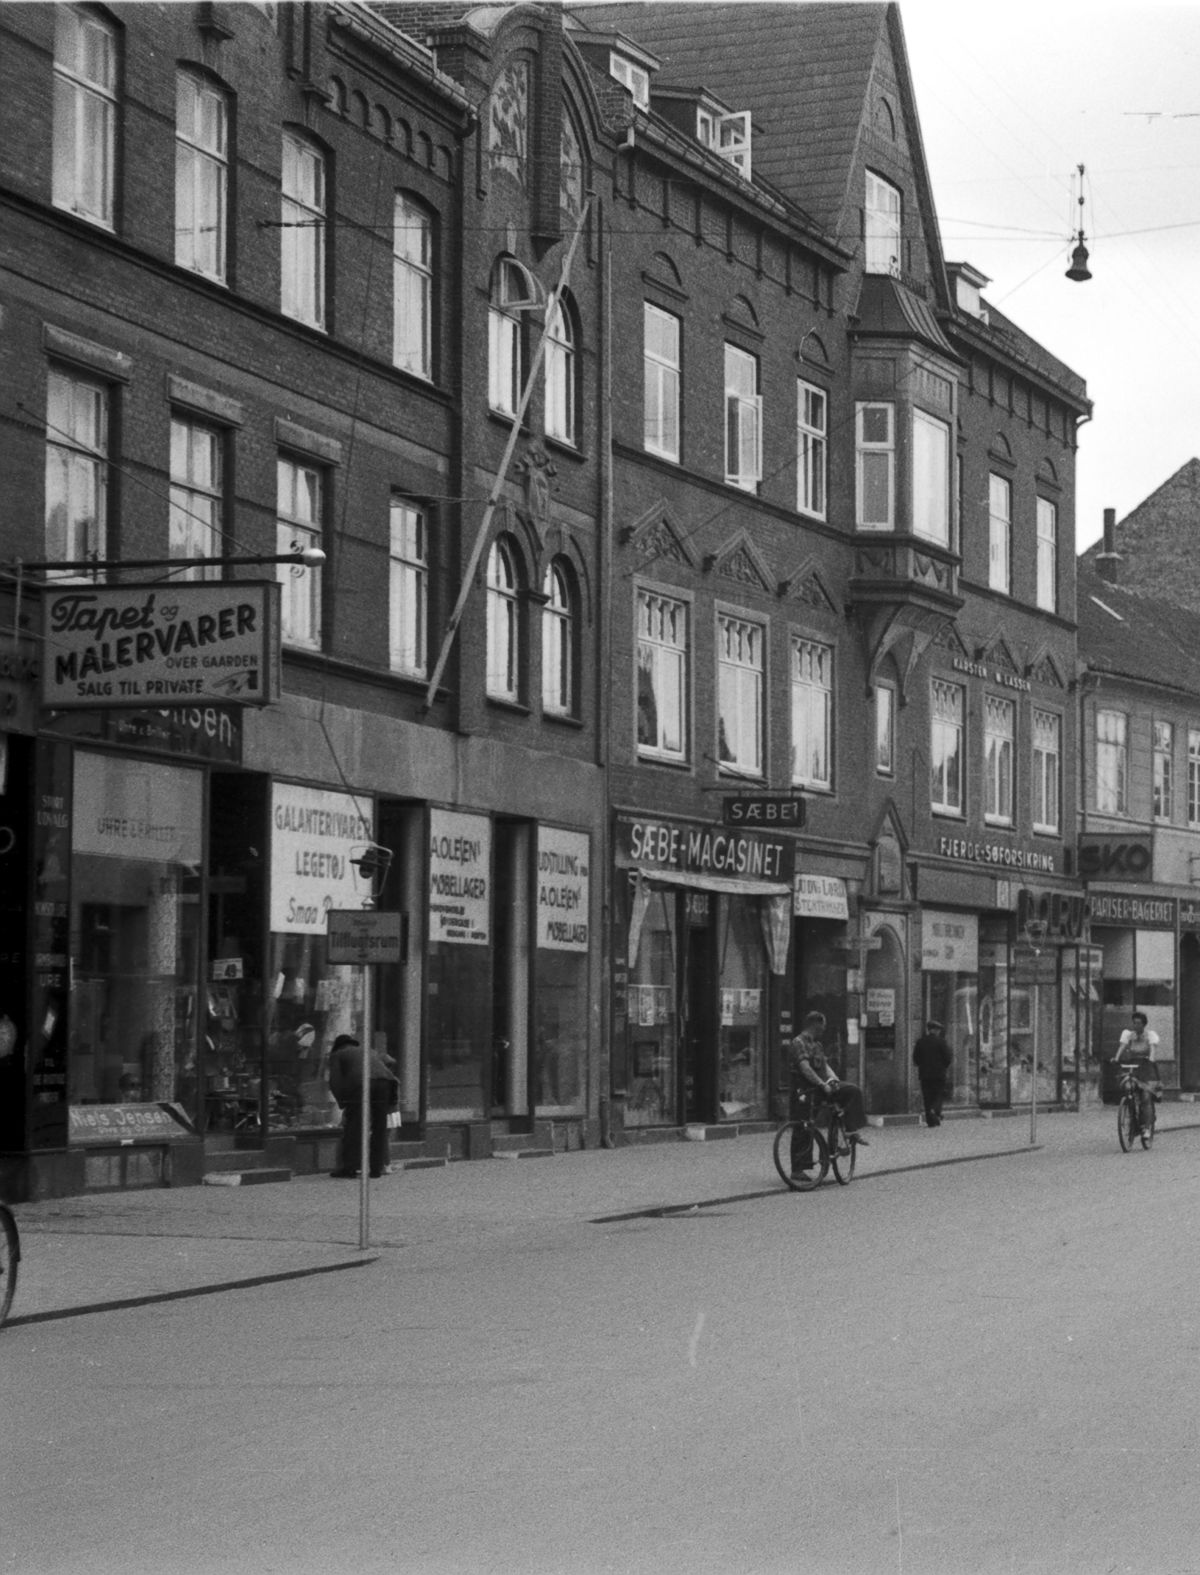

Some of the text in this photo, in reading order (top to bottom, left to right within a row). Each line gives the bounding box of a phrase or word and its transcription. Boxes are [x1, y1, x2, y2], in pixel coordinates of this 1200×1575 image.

[51, 594, 179, 641] Tapet og
[55, 603, 256, 685] MALERVARER
[165, 655, 258, 669] OVER GAARDEN
[77, 680, 203, 697] SALG TIL PRIVATE
[274, 804, 373, 841] GALANTERIVARER
[296, 851, 345, 880] LEGETØJ
[631, 824, 783, 876] SÆBE-MAGASINET
[286, 896, 318, 924] Smaa
